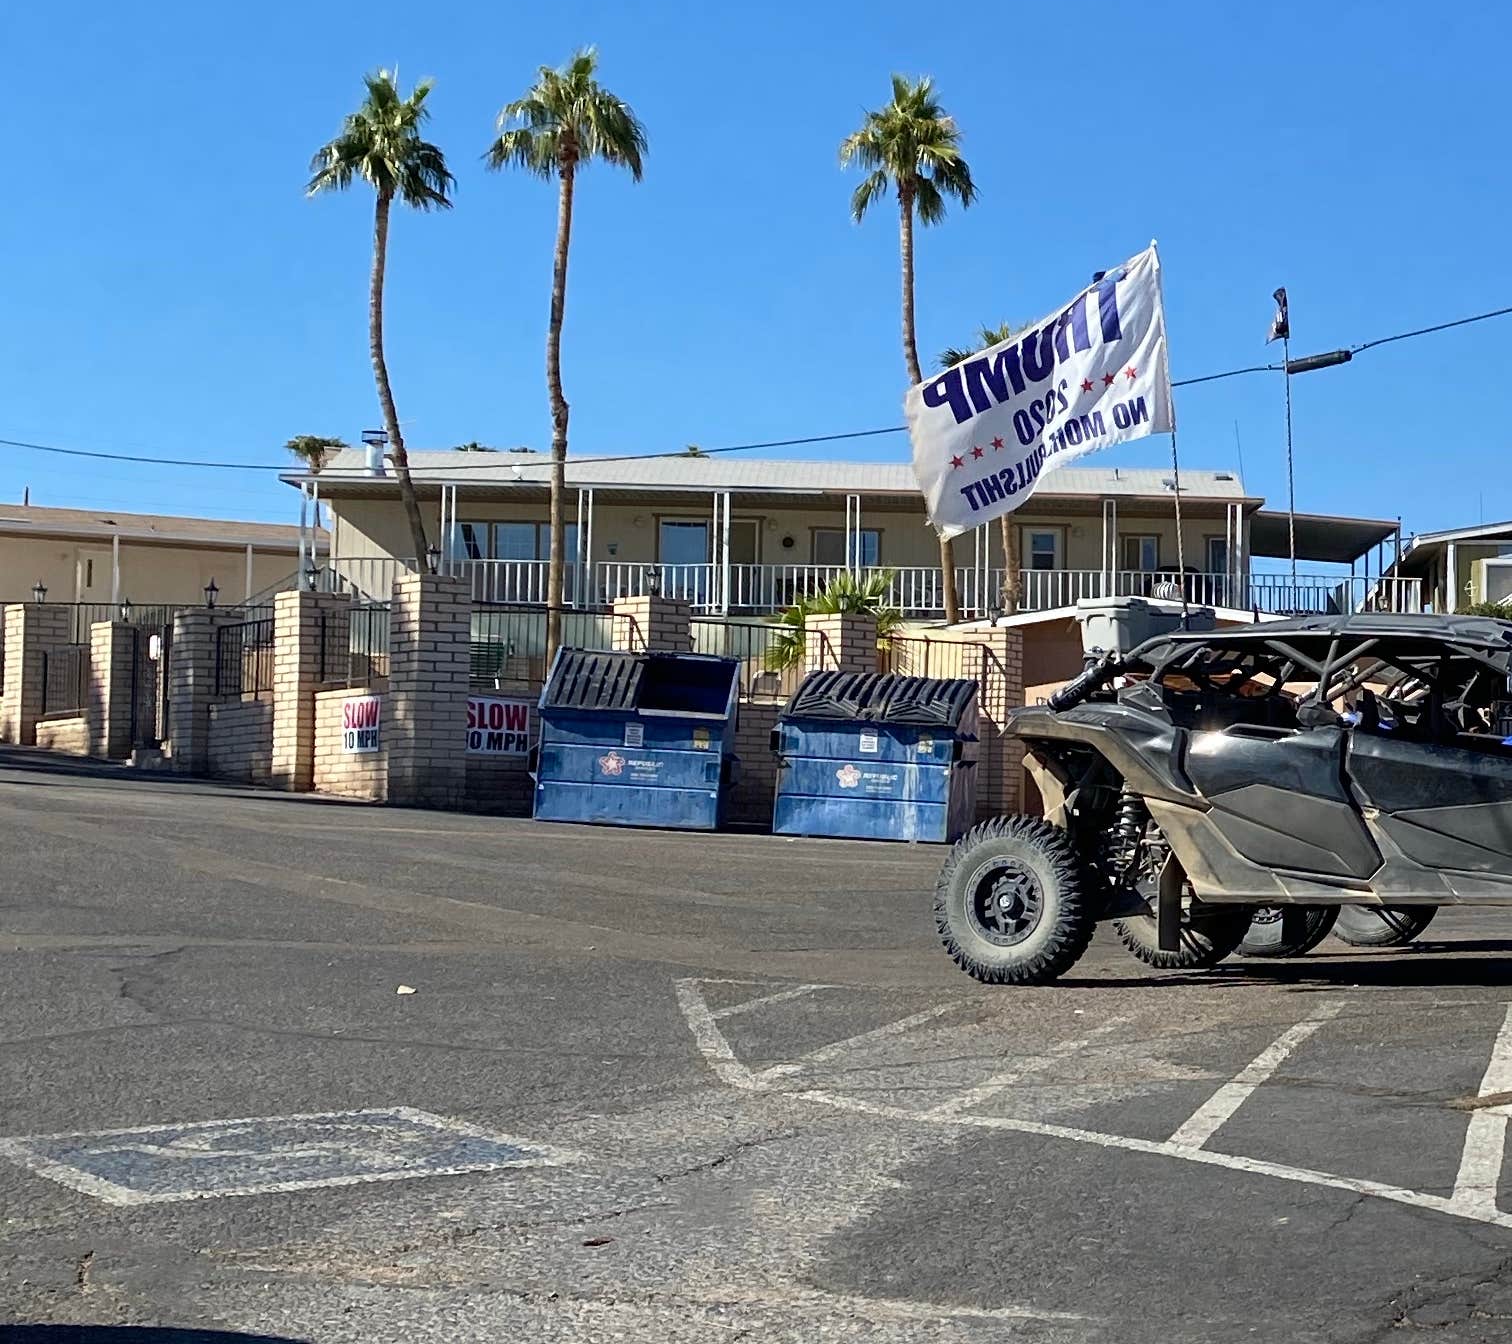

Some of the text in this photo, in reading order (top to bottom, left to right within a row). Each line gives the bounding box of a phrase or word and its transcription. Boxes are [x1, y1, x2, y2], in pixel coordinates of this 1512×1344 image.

[344, 700, 380, 729] SLOW
[466, 701, 528, 731] SLOW
[344, 729, 379, 749] 10 MPH
[486, 733, 528, 752] MPH
